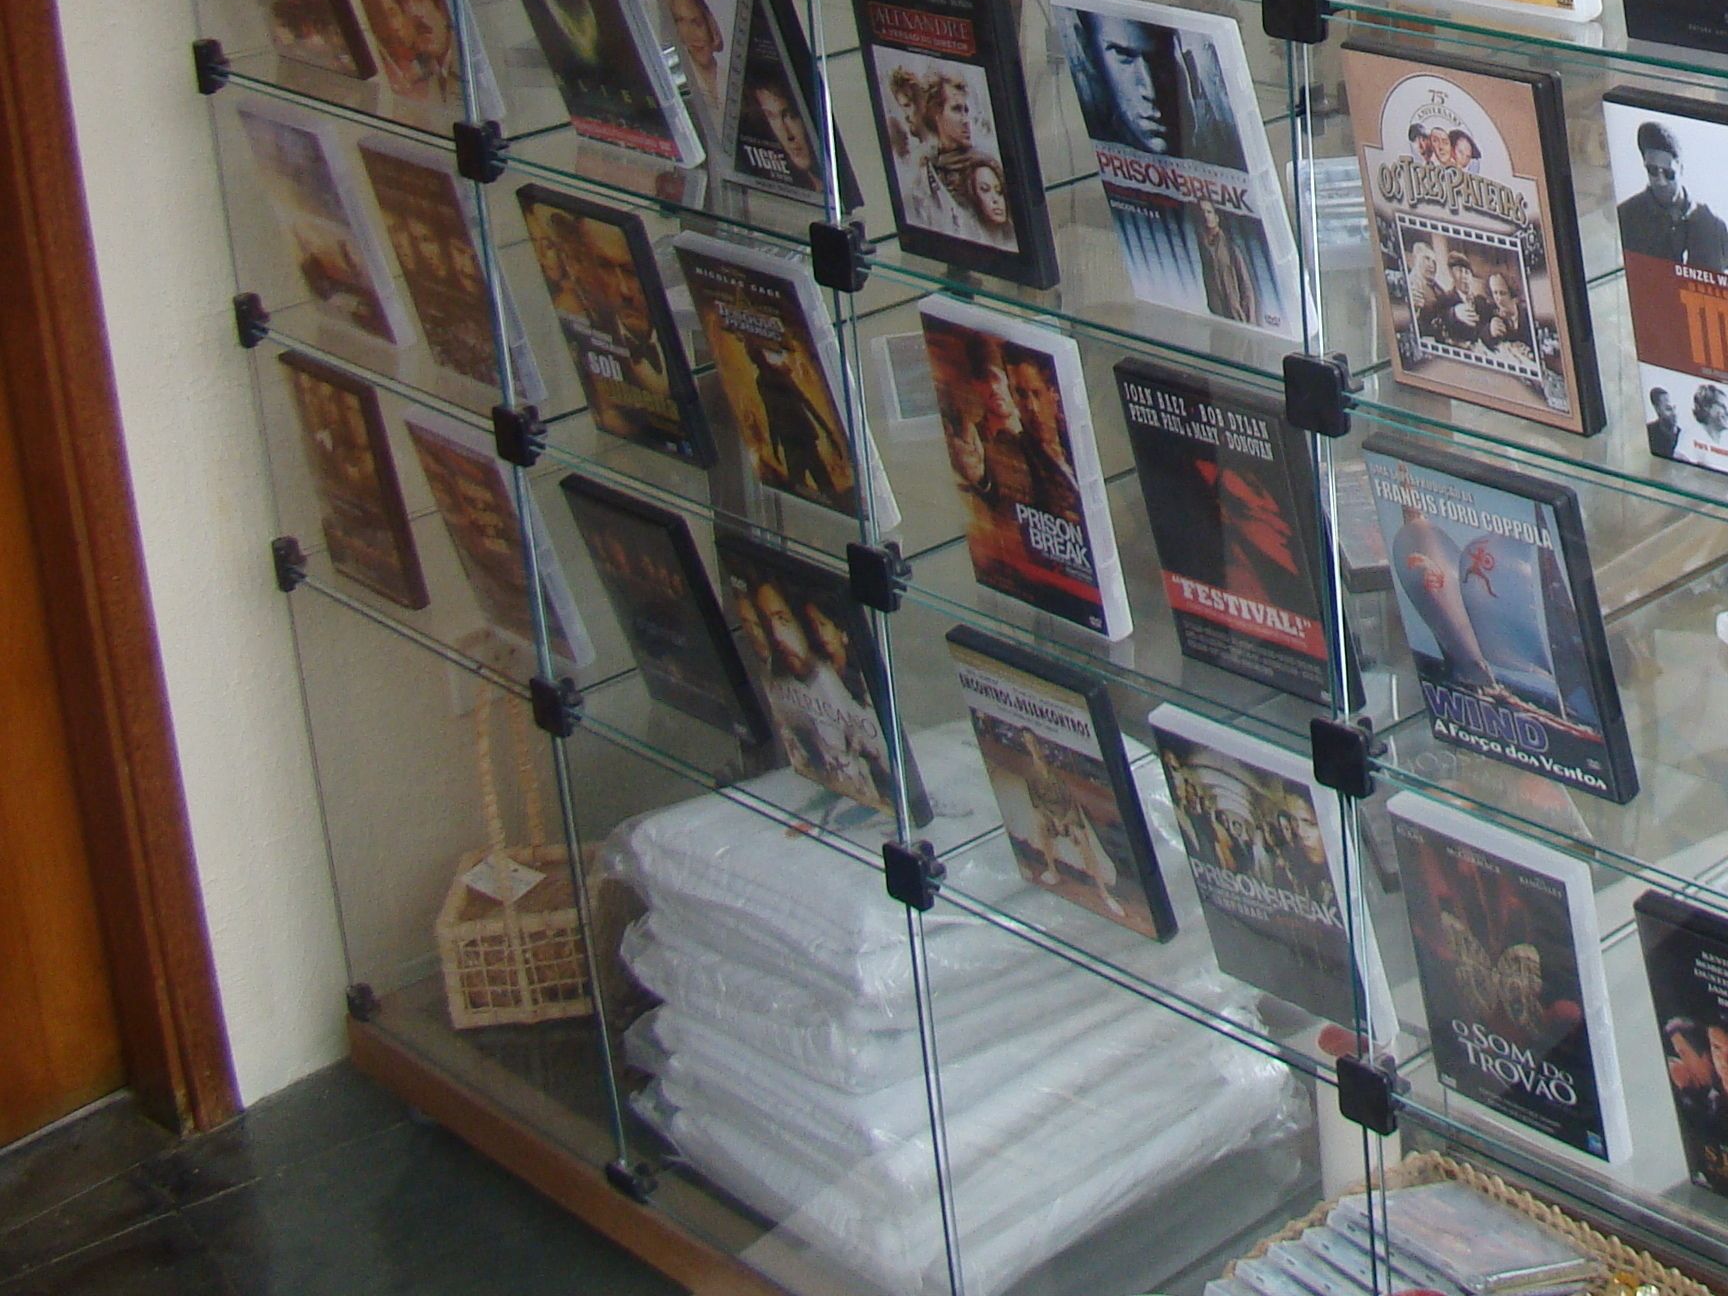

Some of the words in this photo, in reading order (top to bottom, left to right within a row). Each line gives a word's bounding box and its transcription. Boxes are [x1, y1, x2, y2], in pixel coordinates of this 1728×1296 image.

[874, 7, 972, 40] ALEXANDRE
[743, 144, 791, 175] TIGRE
[1377, 162, 1403, 200] OS
[1445, 166, 1529, 229] PATETAS
[695, 267, 745, 289] NICOLAS
[749, 282, 782, 300] CAGE
[1675, 264, 1716, 286] DENZEL
[1123, 382, 1153, 404] JOAN
[1157, 392, 1187, 416] BAEZ
[1199, 403, 1225, 428] BOB
[1228, 411, 1270, 441] DYLAN
[1129, 403, 1161, 428] PETER
[1161, 411, 1186, 435] PAUL
[1191, 421, 1221, 446] MARY
[1226, 432, 1275, 462] DONOVAN
[1016, 503, 1084, 547] PRISON
[1375, 478, 1438, 515] FRANCIS
[1439, 499, 1480, 529] FORD
[1482, 512, 1554, 551] COPPOLA
[1029, 526, 1091, 569] BREAK
[959, 671, 1013, 707] ENCONTROS
[1015, 696, 1091, 738] DESENCONTROS
[1422, 682, 1550, 753] WIND
[1434, 718, 1448, 735] A
[1449, 724, 1502, 754] Força
[1503, 746, 1540, 769] dos
[1538, 753, 1608, 792] Ventos
[1452, 1018, 1468, 1036] O
[1470, 1023, 1535, 1068] SOM
[1542, 1060, 1574, 1086] DO
[1458, 1036, 1578, 1106] TROVÃO
